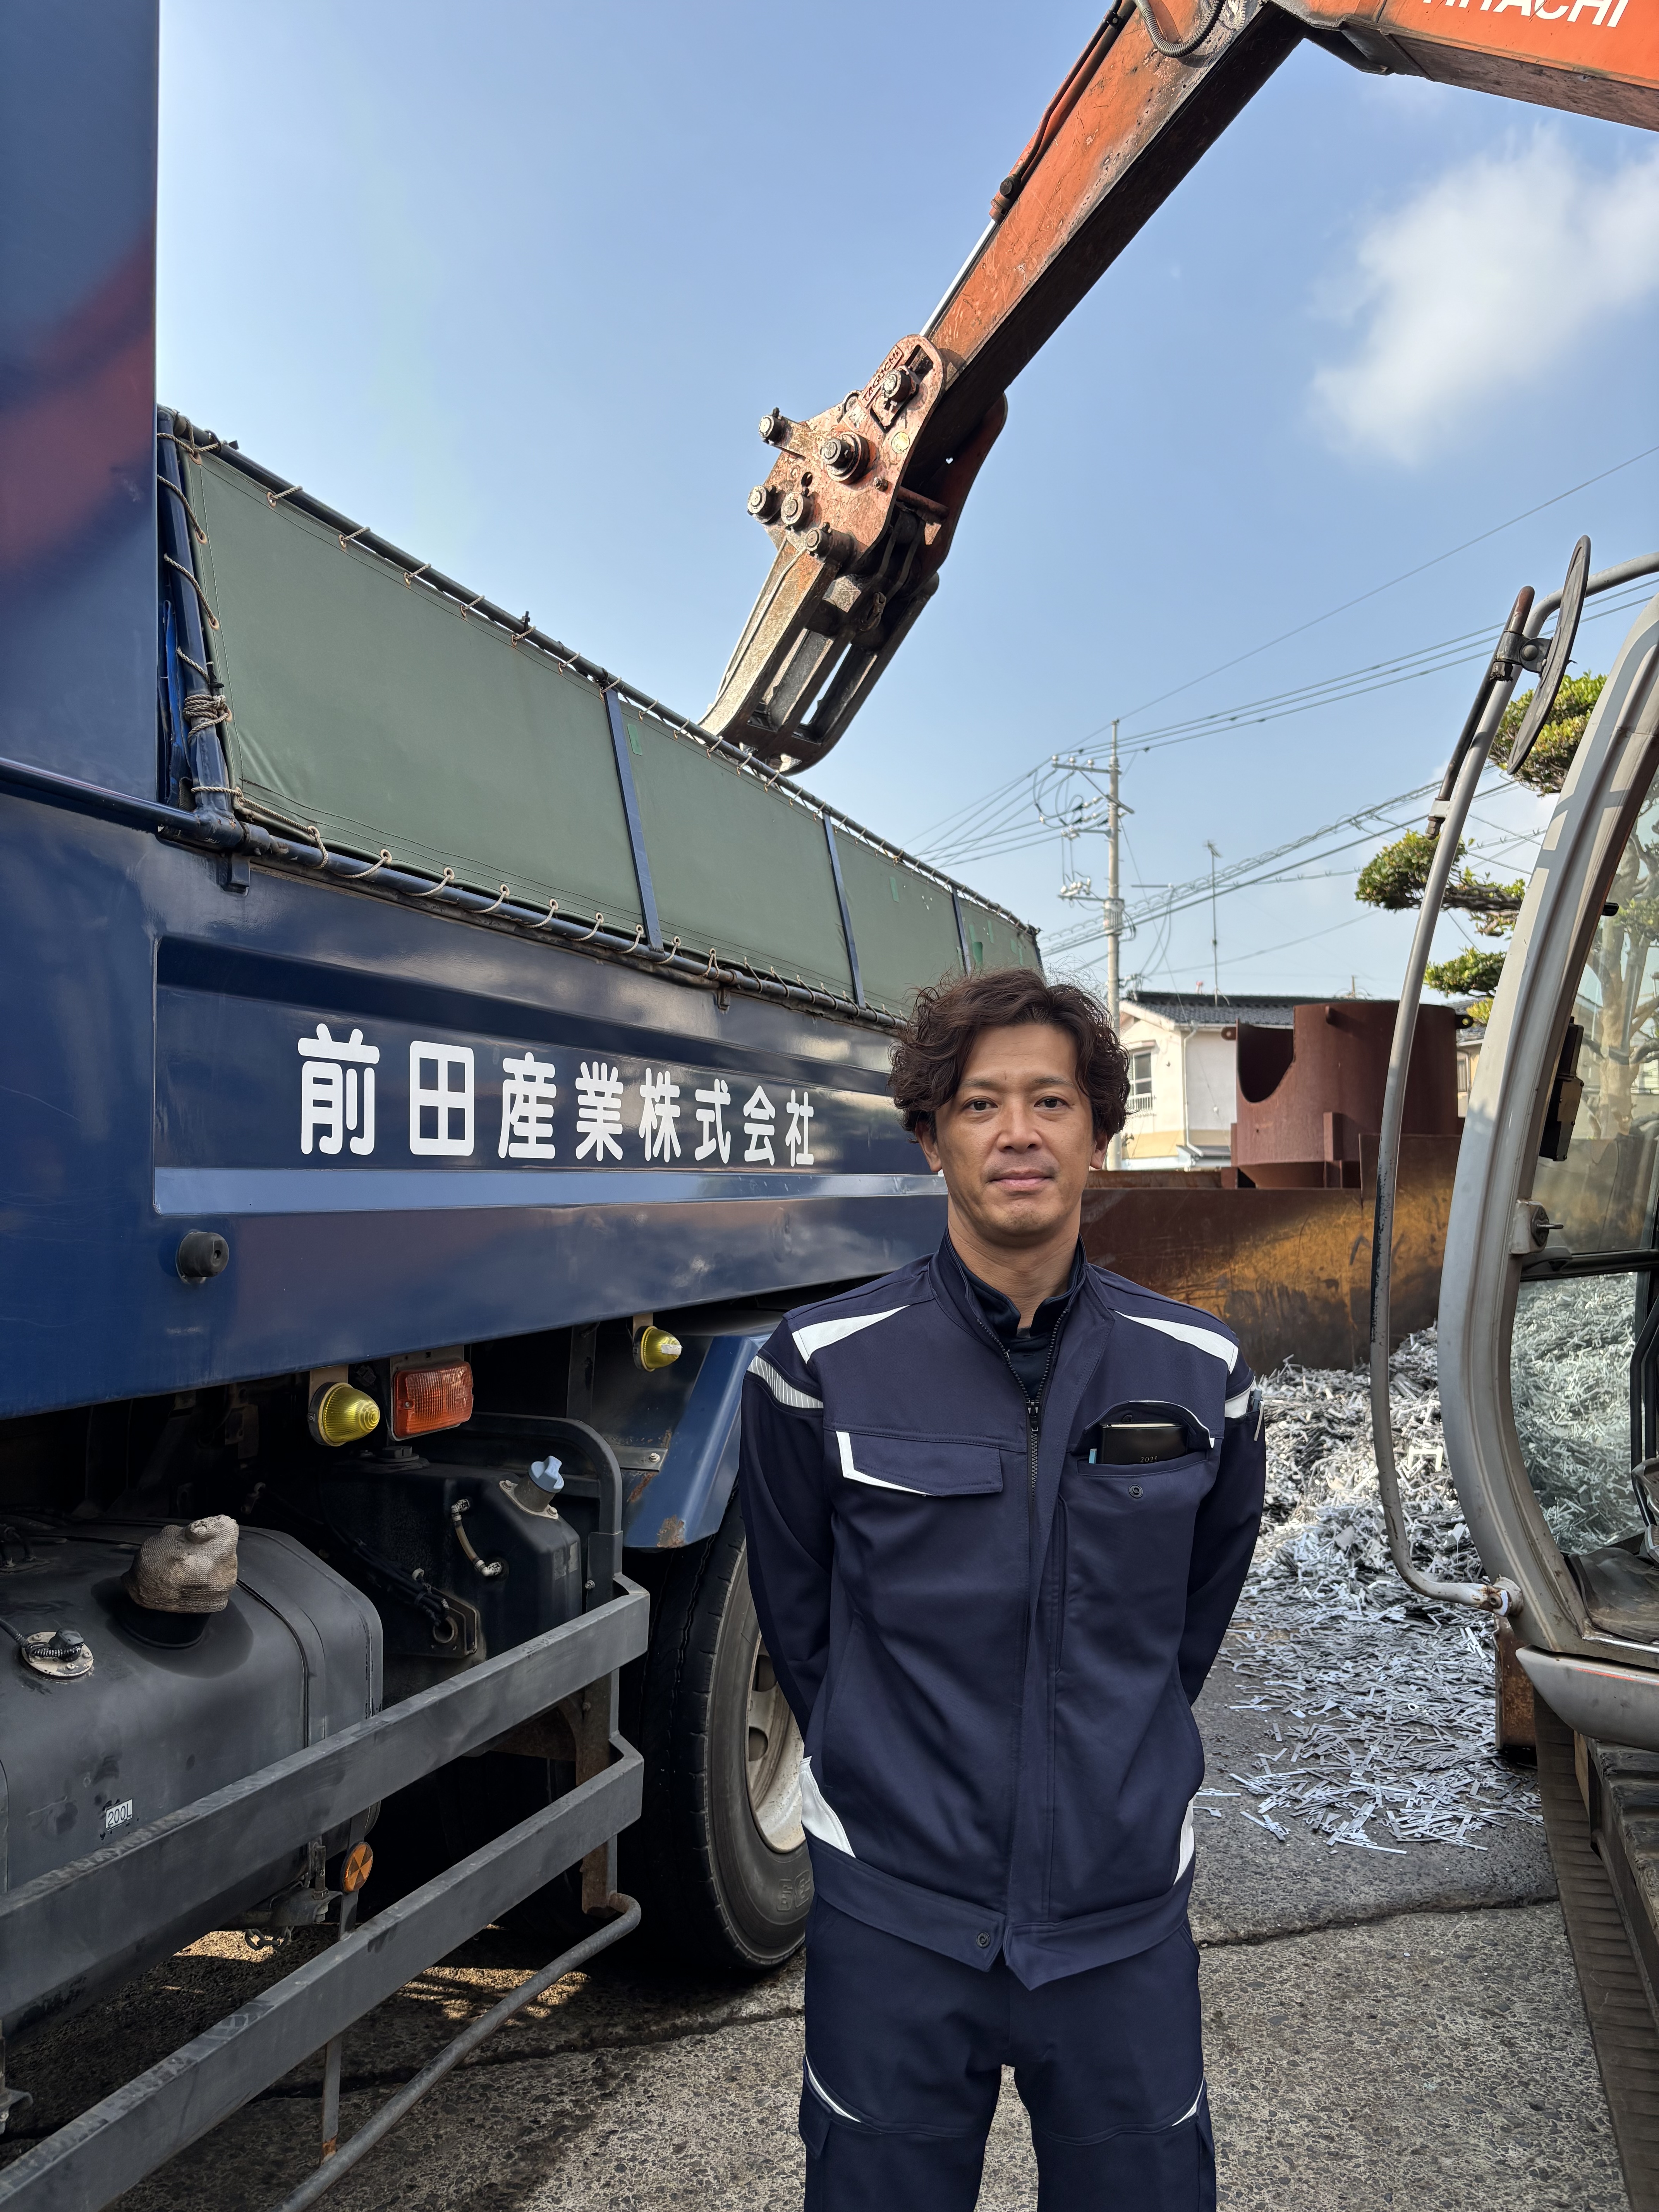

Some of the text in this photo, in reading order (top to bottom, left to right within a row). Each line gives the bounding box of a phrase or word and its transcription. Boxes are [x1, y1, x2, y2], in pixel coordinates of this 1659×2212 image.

[297, 1023, 815, 1168] 前田産業株式会社
[108, 1803, 132, 1827] 200L
